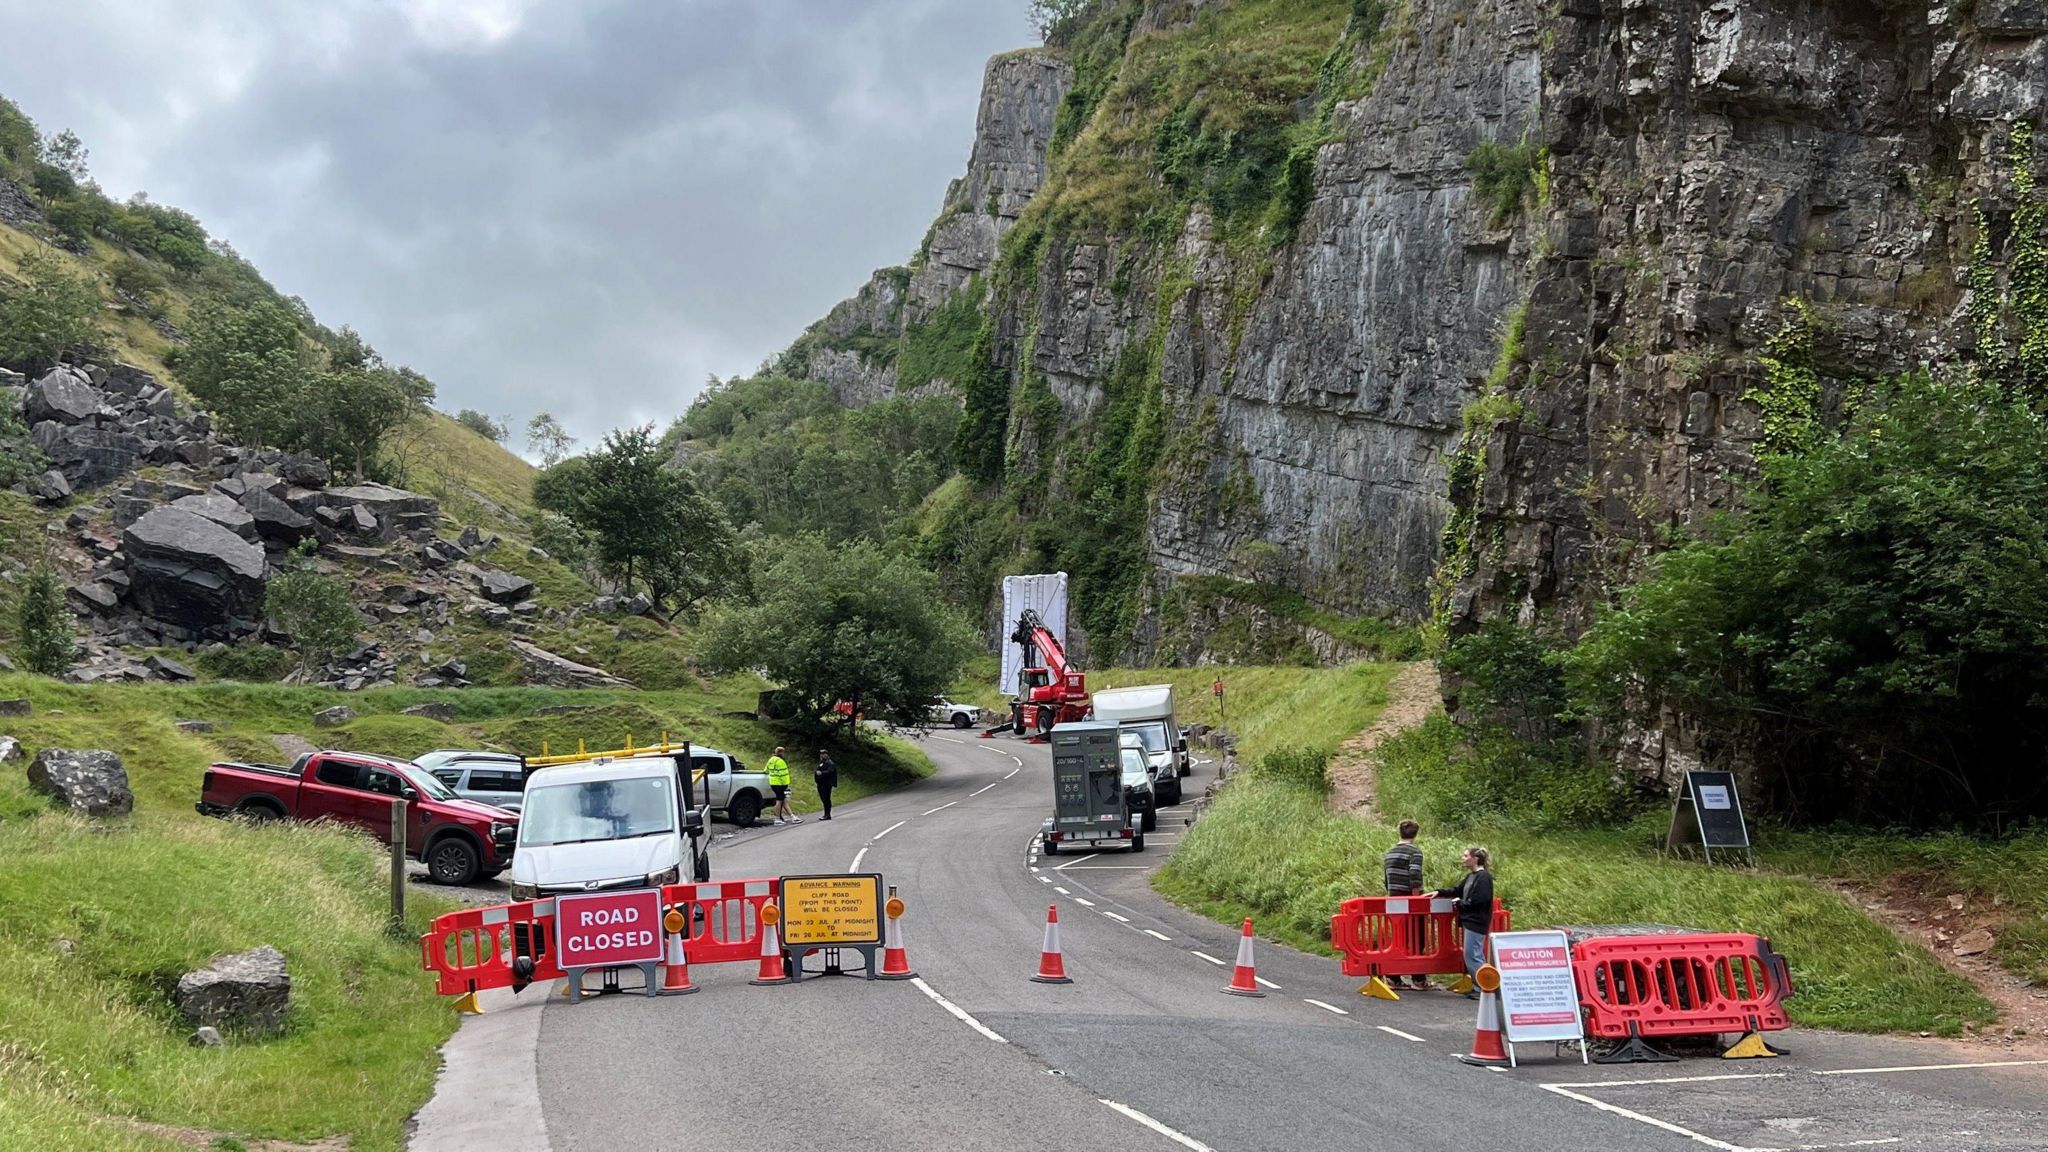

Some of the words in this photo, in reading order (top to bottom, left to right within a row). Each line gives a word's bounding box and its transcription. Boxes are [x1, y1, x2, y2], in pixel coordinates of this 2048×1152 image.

[580, 907, 640, 927] ROAD
[568, 930, 654, 952] CLOSED
[1511, 949, 1554, 960] CAUTION
